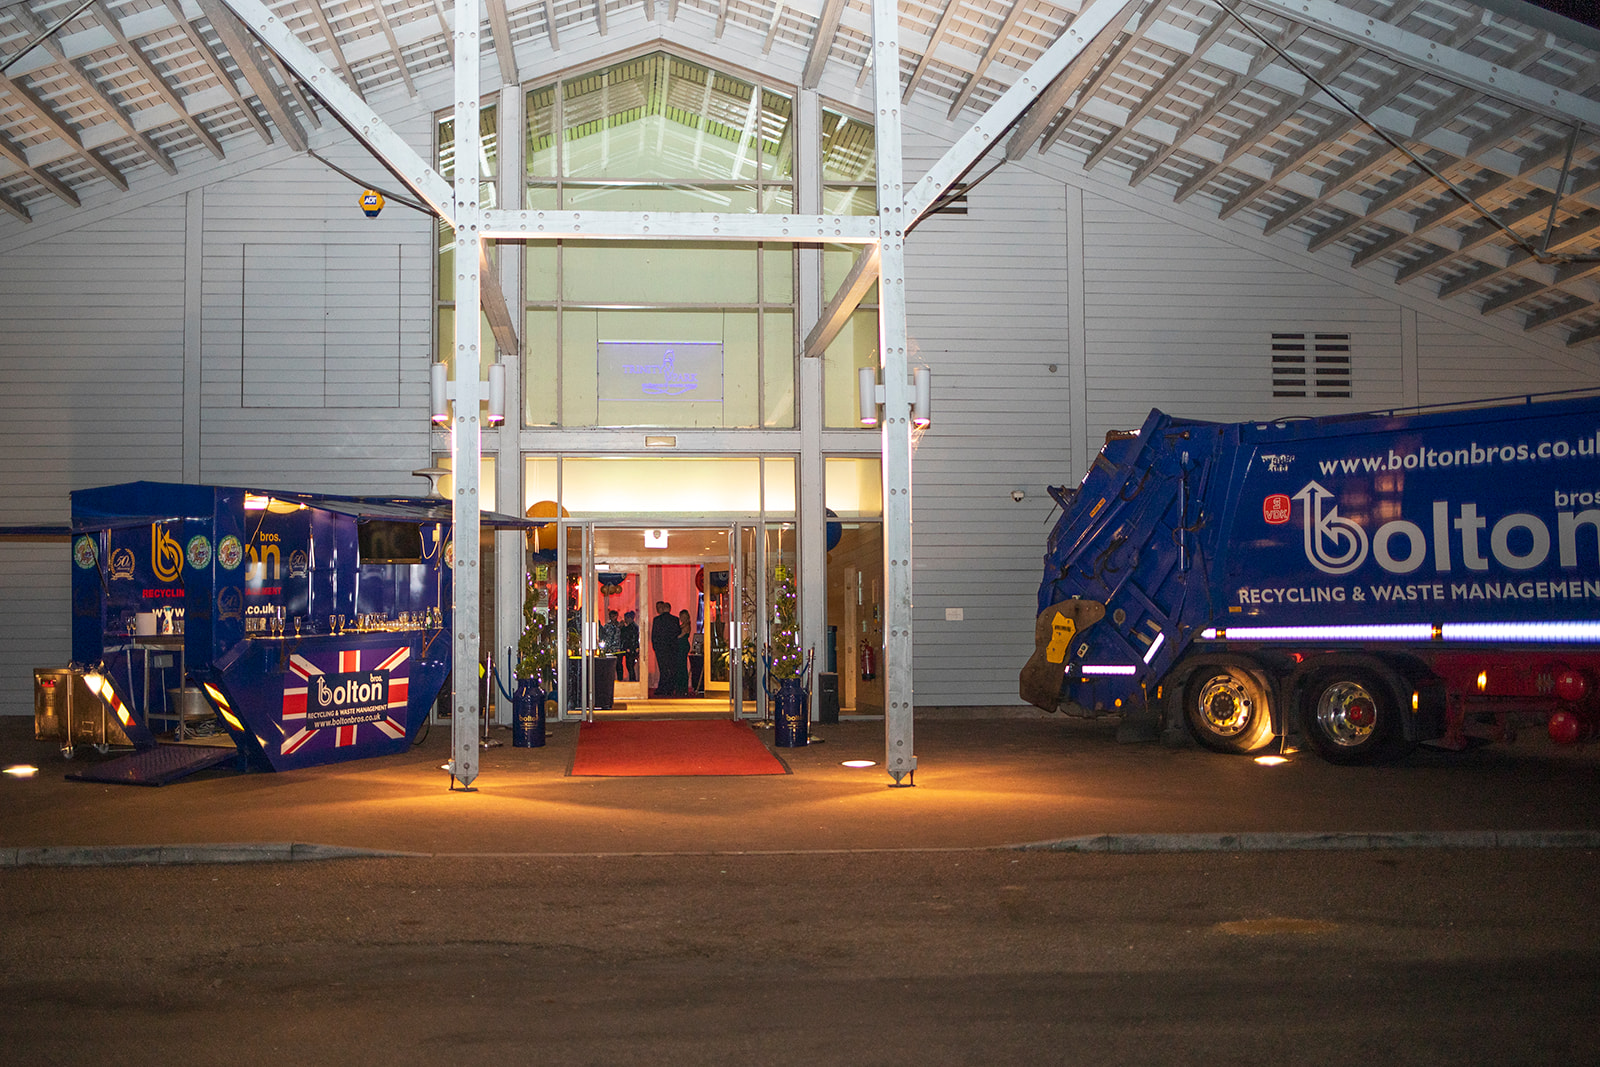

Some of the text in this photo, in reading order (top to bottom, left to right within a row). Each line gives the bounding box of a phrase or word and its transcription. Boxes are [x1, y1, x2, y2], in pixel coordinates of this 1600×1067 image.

[364, 196, 377, 204] ADT
[622, 364, 664, 374] TRINITY
[671, 373, 698, 382] PARK
[1319, 431, 1600, 476] www.boltonbros.co.u
[1265, 509, 1289, 520] VDK
[1291, 480, 1600, 575] bolton
[142, 589, 184, 598] RECYCLIN
[1239, 581, 1600, 604] RECYCLING & WASTE MANAGEMEN
[317, 676, 382, 705] bolton
[308, 705, 387, 719] RECYCLING & WASTE MANAGEMENT
[314, 713, 380, 727] www.boltonbros.co.uk
